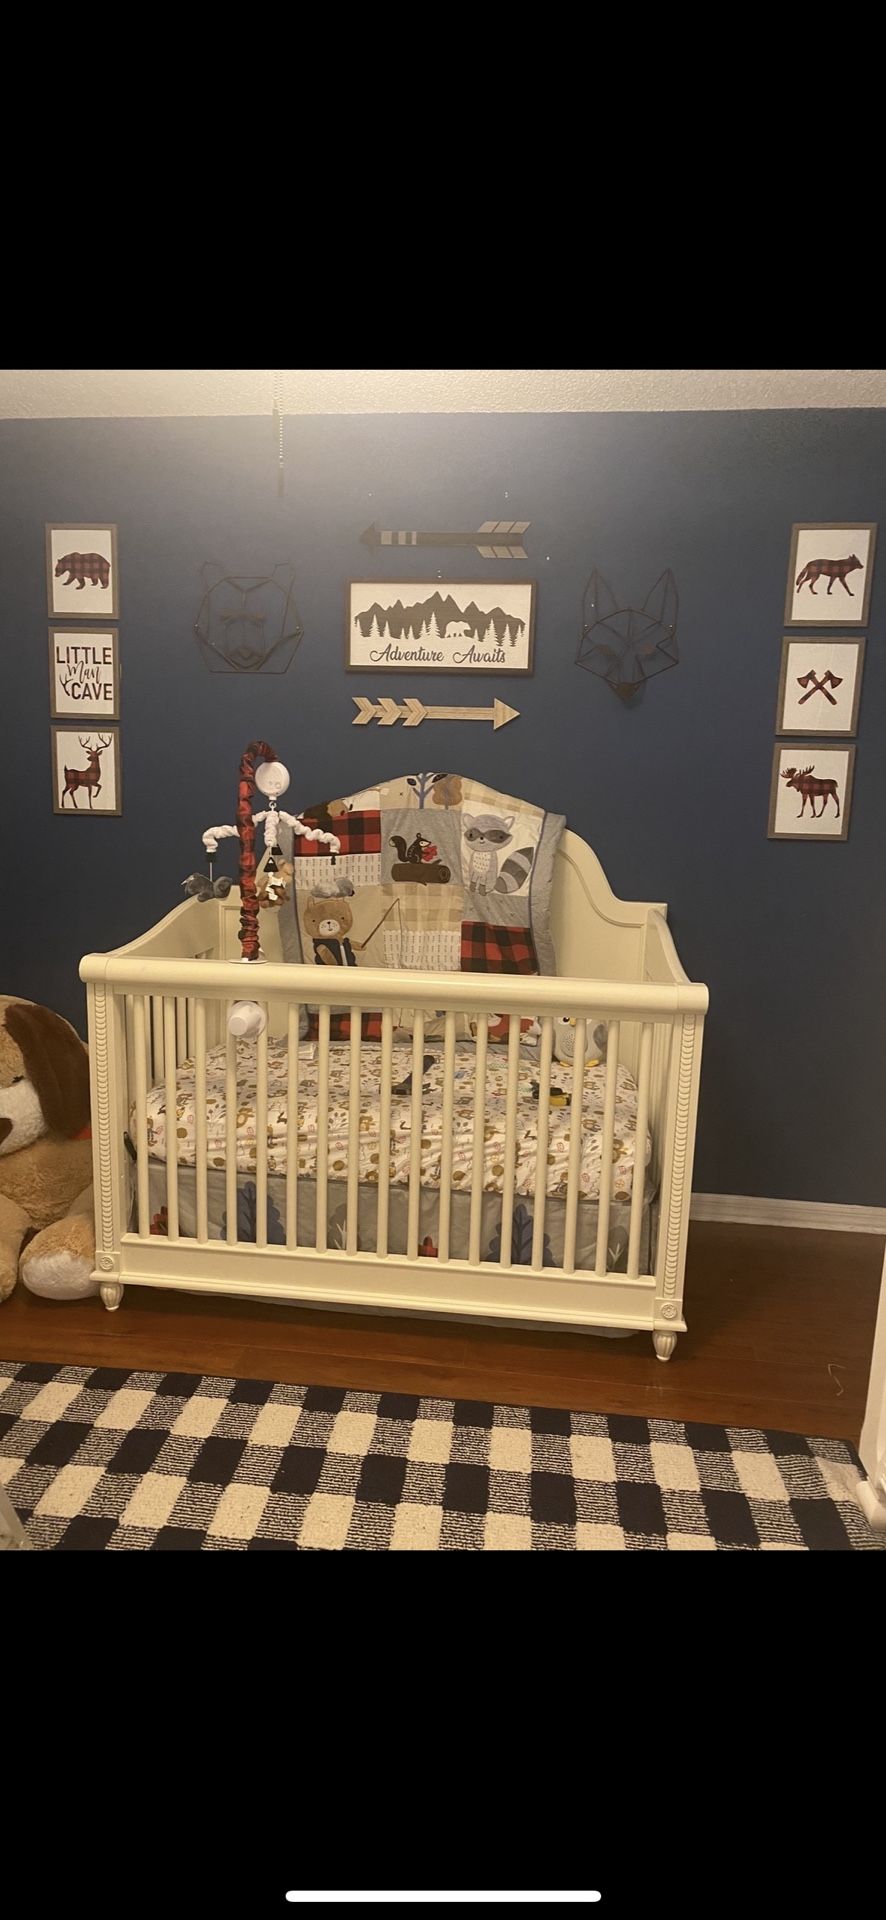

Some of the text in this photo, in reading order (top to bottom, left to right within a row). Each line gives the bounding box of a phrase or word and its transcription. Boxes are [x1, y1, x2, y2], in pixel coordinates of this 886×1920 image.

[56, 646, 112, 665] LITTLE
[369, 643, 506, 664] Adventure Awaits
[71, 682, 113, 701] CAVE
